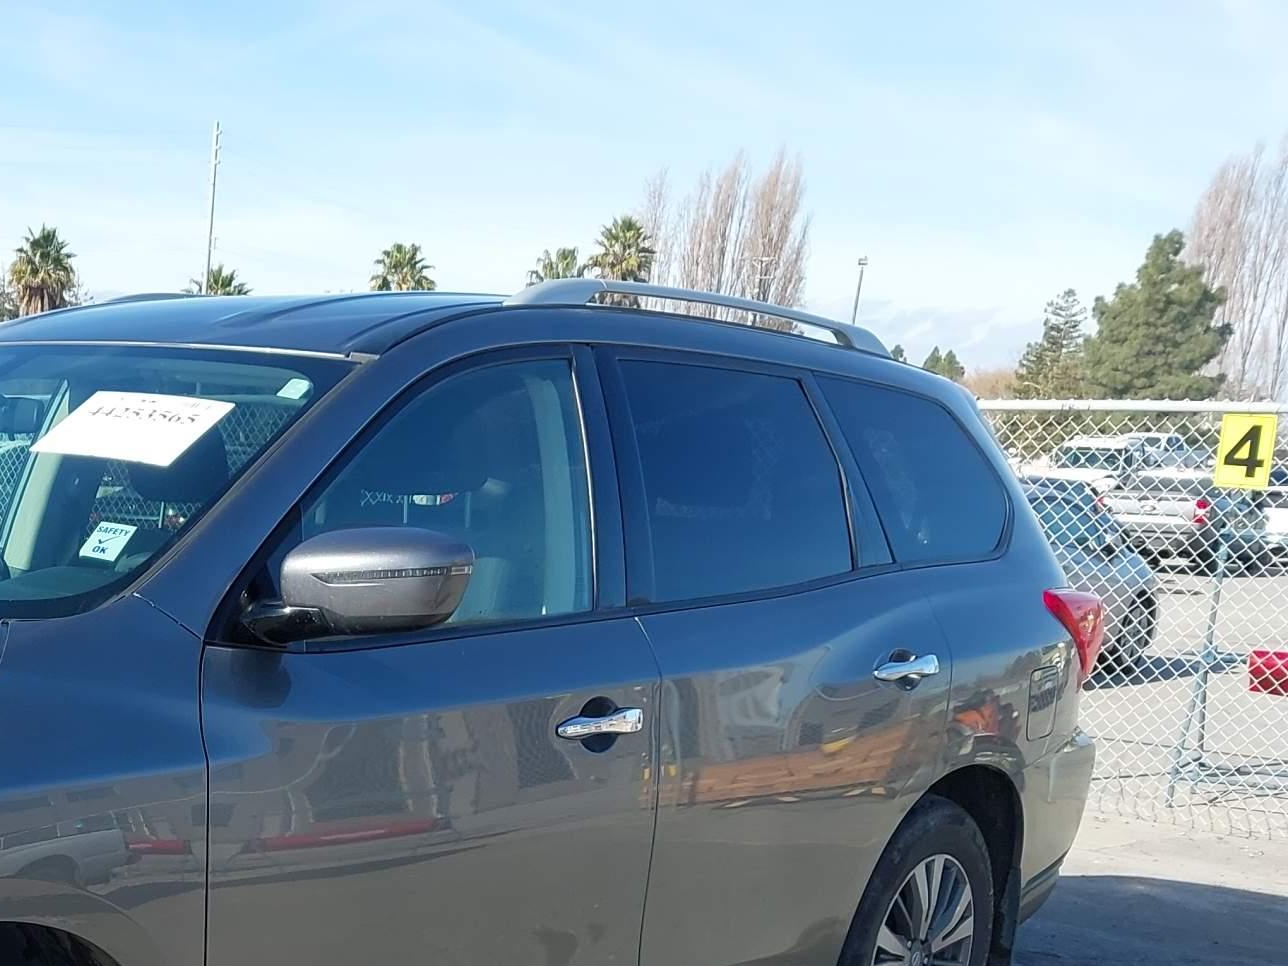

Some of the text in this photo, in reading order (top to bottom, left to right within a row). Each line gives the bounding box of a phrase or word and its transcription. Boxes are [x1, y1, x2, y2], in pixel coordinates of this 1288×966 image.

[1224, 425, 1264, 478] 4
[96, 526, 131, 537] SAFETY
[92, 545, 109, 554] OK
